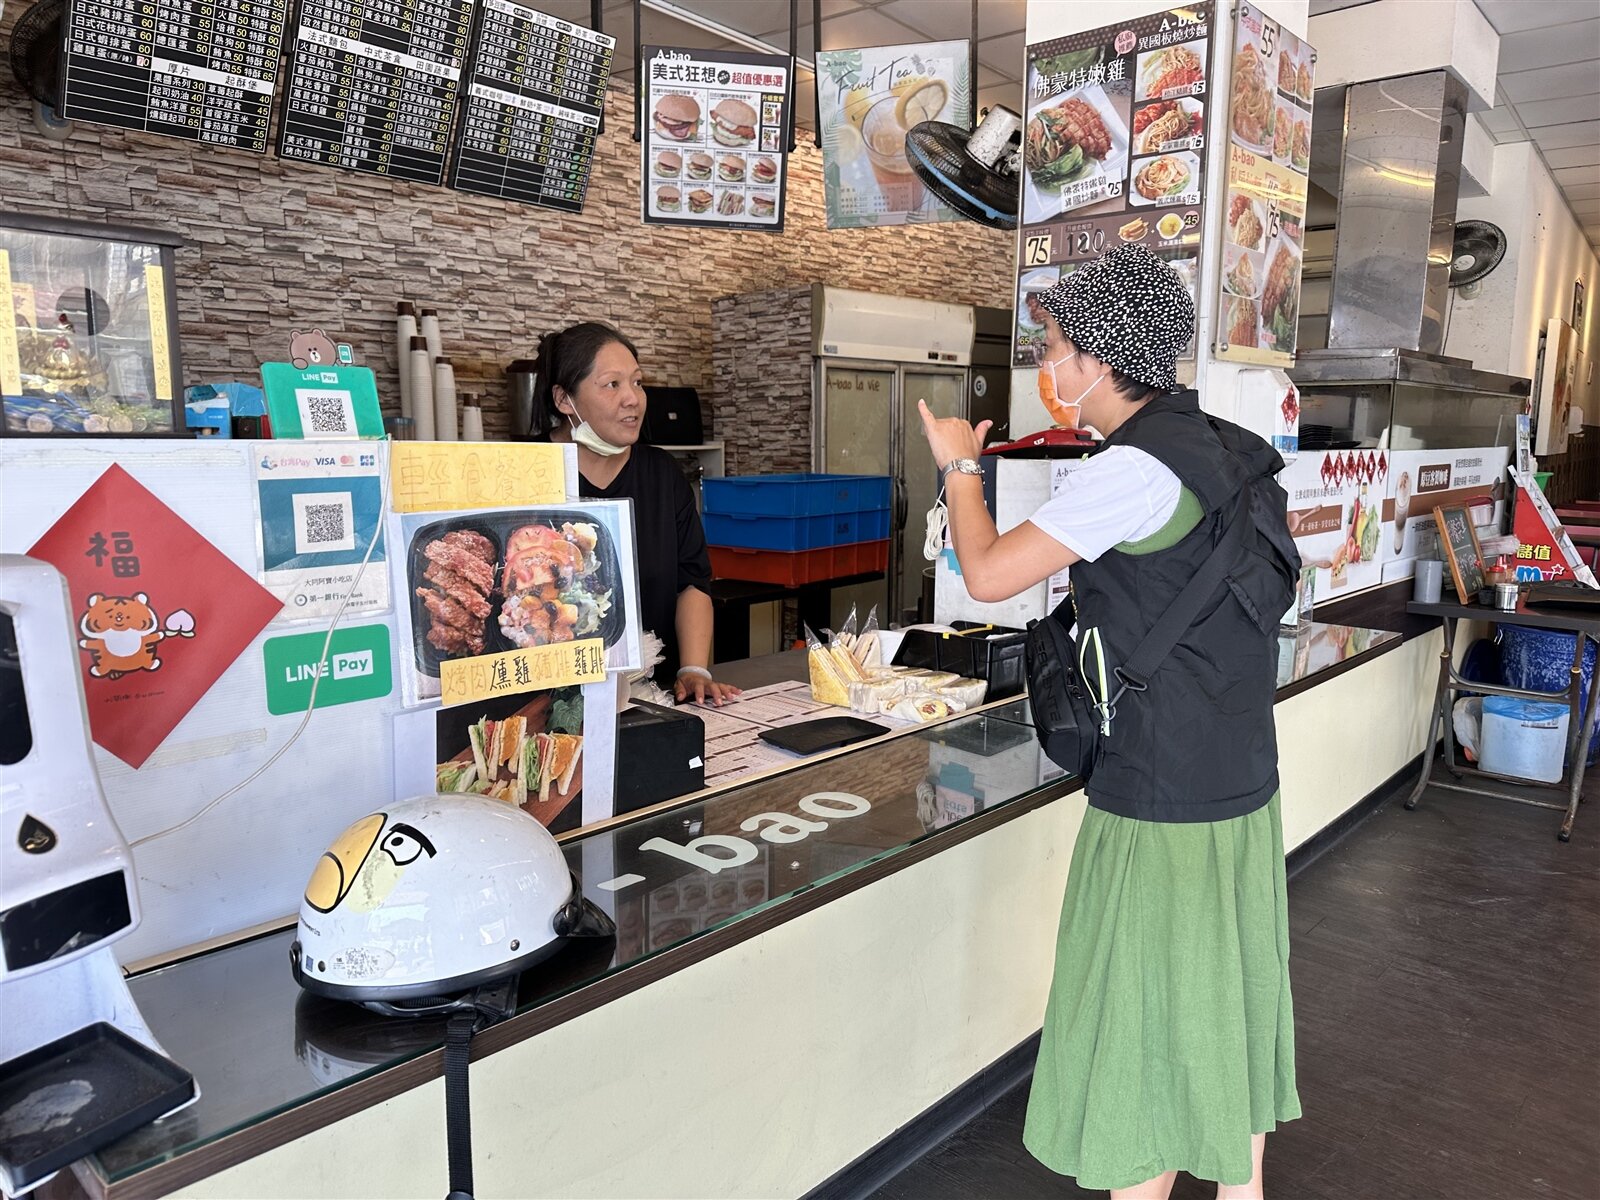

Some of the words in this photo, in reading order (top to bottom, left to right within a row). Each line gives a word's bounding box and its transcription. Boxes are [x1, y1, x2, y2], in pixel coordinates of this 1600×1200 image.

[239, 2, 250, 12] 45
[271, 10, 282, 21] 55
[141, 17, 153, 28] 60
[159, 8, 190, 24] 烤肉蛋
[198, 18, 211, 29] 55
[217, 9, 237, 22] 火腿
[237, 15, 248, 25] 50
[250, 18, 268, 30] 特酥
[269, 23, 280, 33] 60
[350, 17, 360, 27] 60
[75, 15, 137, 38] 日式花枝排蛋
[139, 30, 152, 41] 60
[457, 25, 466, 35] 60
[521, 20, 531, 30] 35
[197, 31, 209, 41] 55
[215, 22, 235, 35] 培根
[235, 27, 246, 37] 50
[248, 30, 266, 42] 特酥
[267, 35, 278, 45] 60
[348, 29, 358, 39] 60
[519, 31, 529, 41] 35
[1138, 23, 1208, 51] 異國板燒炒麵
[1261, 24, 1275, 58] 55
[138, 44, 150, 54] 60
[195, 43, 208, 54] 50
[234, 40, 245, 50] 50
[246, 43, 264, 55] 特酥
[265, 47, 277, 57] 60
[299, 41, 335, 58] 火腿起司
[344, 53, 354, 63] 55
[655, 49, 692, 62] A-bao
[167, 62, 190, 76] 厚片
[211, 59, 230, 72] 烤肉
[231, 64, 241, 74] 55
[243, 67, 261, 78] 特酥
[262, 71, 273, 81] 65
[393, 66, 403, 75] 15
[653, 63, 716, 83] 美式狂想
[153, 72, 191, 88] 果醬系列
[192, 81, 204, 90] 30
[731, 71, 784, 88] 超值優惠選
[835, 66, 880, 105] Fruit
[878, 56, 913, 91] Tea
[1033, 58, 1126, 99] 佛蒙特嫩雞
[446, 80, 455, 89] 40
[151, 84, 189, 100] 起司奶油
[191, 93, 202, 103] 40
[338, 88, 348, 97] 55
[389, 89, 399, 97] 30
[444, 91, 453, 100] 40
[258, 94, 269, 103] 40
[189, 105, 201, 115] 55
[256, 106, 268, 115] 45
[335, 110, 345, 119] 65
[385, 110, 395, 119] 40
[187, 118, 199, 127] 65
[255, 117, 266, 127] 45
[503, 116, 512, 124] 45
[383, 121, 393, 130] 40
[438, 123, 447, 132] 50
[252, 141, 262, 149] 55
[329, 143, 339, 152] 50
[379, 143, 389, 151] 40
[328, 154, 338, 163] 60
[1232, 151, 1256, 167] A-bao
[1107, 181, 1121, 196] 75
[1184, 214, 1199, 226] 45
[1269, 211, 1280, 238] 75
[1066, 228, 1107, 256] 120
[1028, 237, 1049, 264] 75
[1019, 337, 1030, 345] 65
[301, 373, 321, 381] LINE
[856, 375, 864, 391] la
[315, 457, 336, 466] VISA
[85, 531, 140, 578] 福
[1516, 544, 1552, 560] 儲值
[309, 592, 340, 602] 第一銀行
[285, 660, 330, 683] LINE
[338, 658, 369, 672] Pay
